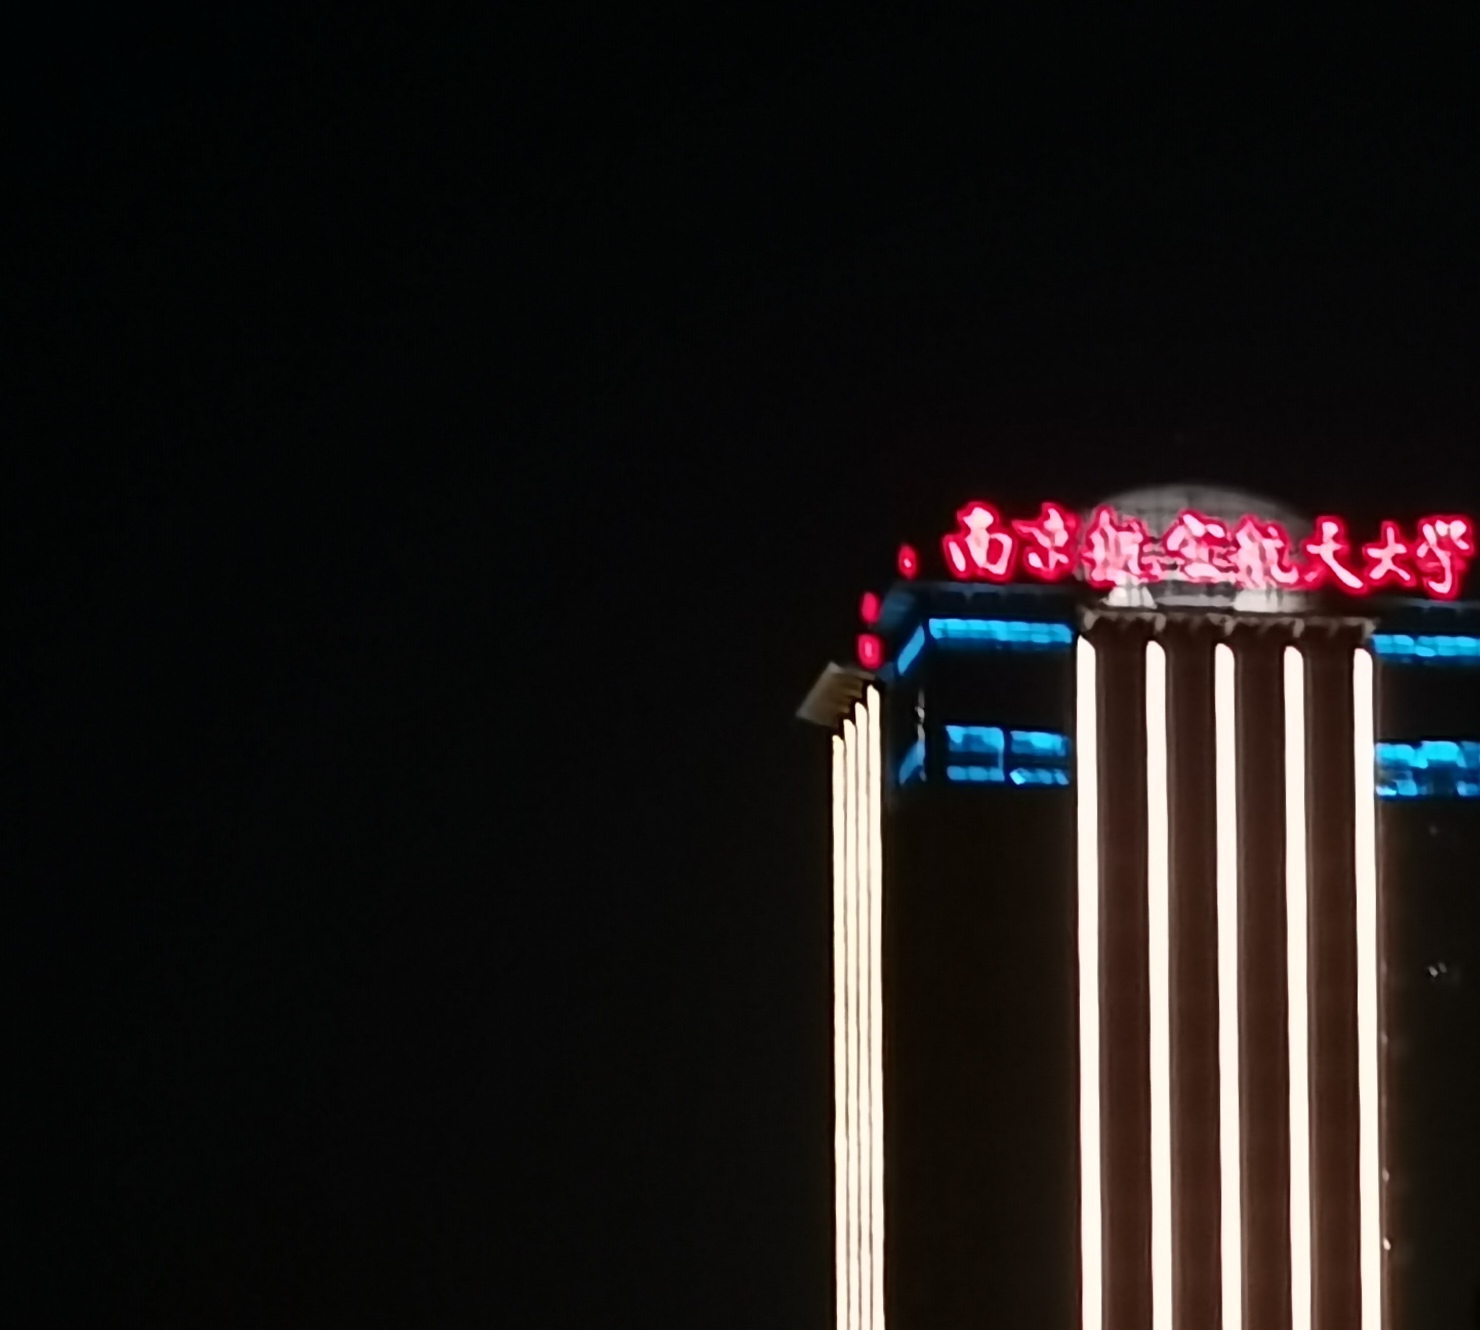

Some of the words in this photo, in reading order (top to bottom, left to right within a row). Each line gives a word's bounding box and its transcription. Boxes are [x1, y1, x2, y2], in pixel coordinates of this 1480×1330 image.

[942, 501, 1475, 600] 南京航空航天大学
